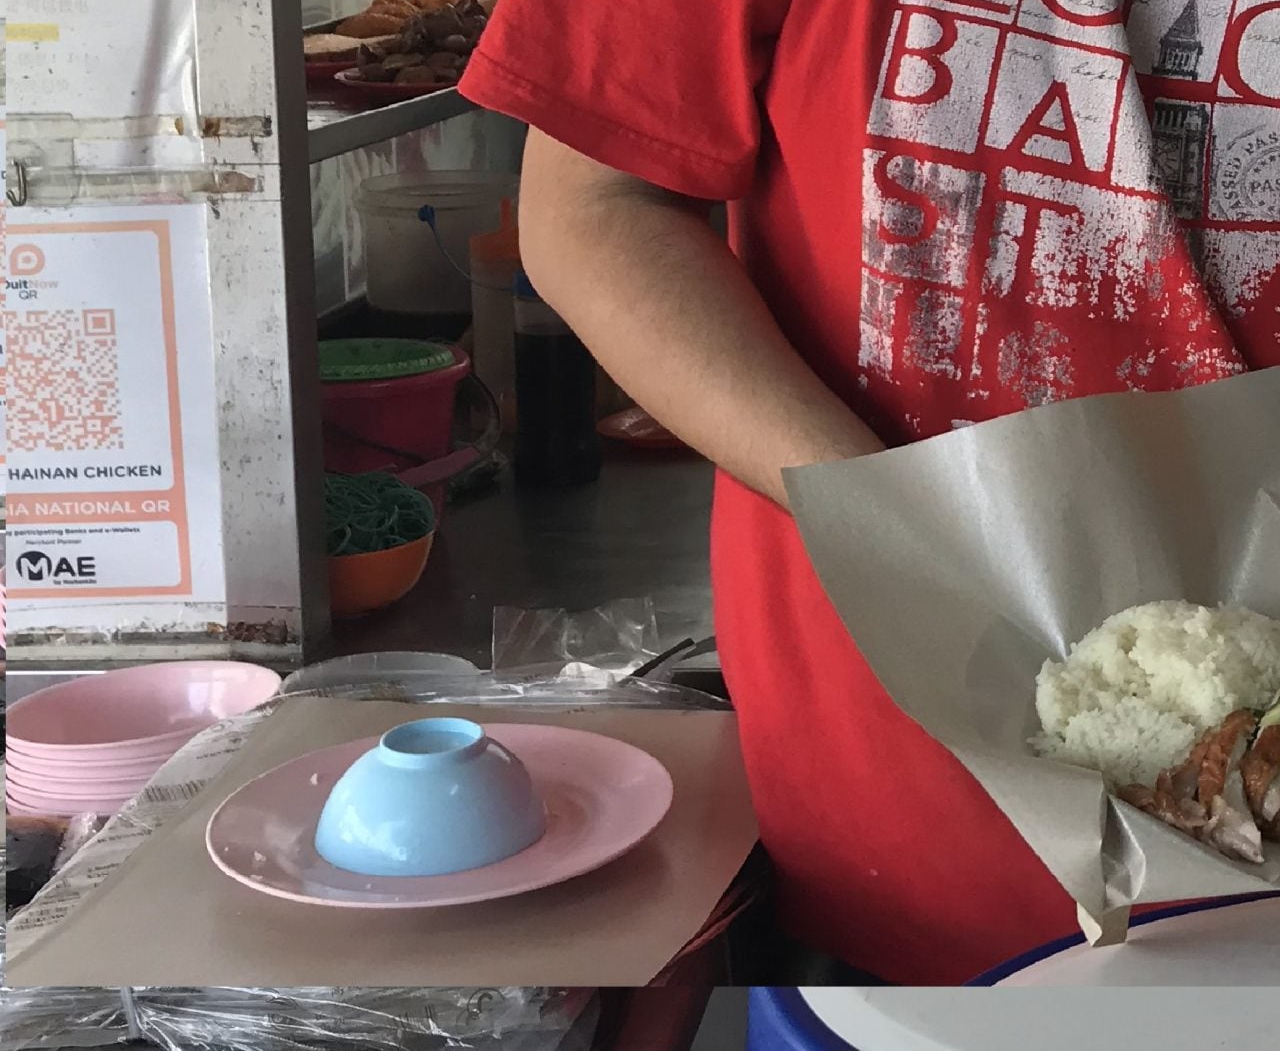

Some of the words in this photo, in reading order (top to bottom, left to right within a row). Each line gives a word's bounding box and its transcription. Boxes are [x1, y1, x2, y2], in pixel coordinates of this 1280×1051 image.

[18, 289, 38, 300] QR
[8, 466, 78, 481] HAINAN
[83, 464, 162, 479] CHICKEN
[6, 502, 30, 517] IA
[35, 500, 136, 517] NATIONAL
[141, 499, 171, 513] QR
[14, 528, 64, 537] participating
[16, 550, 96, 581] MAE
